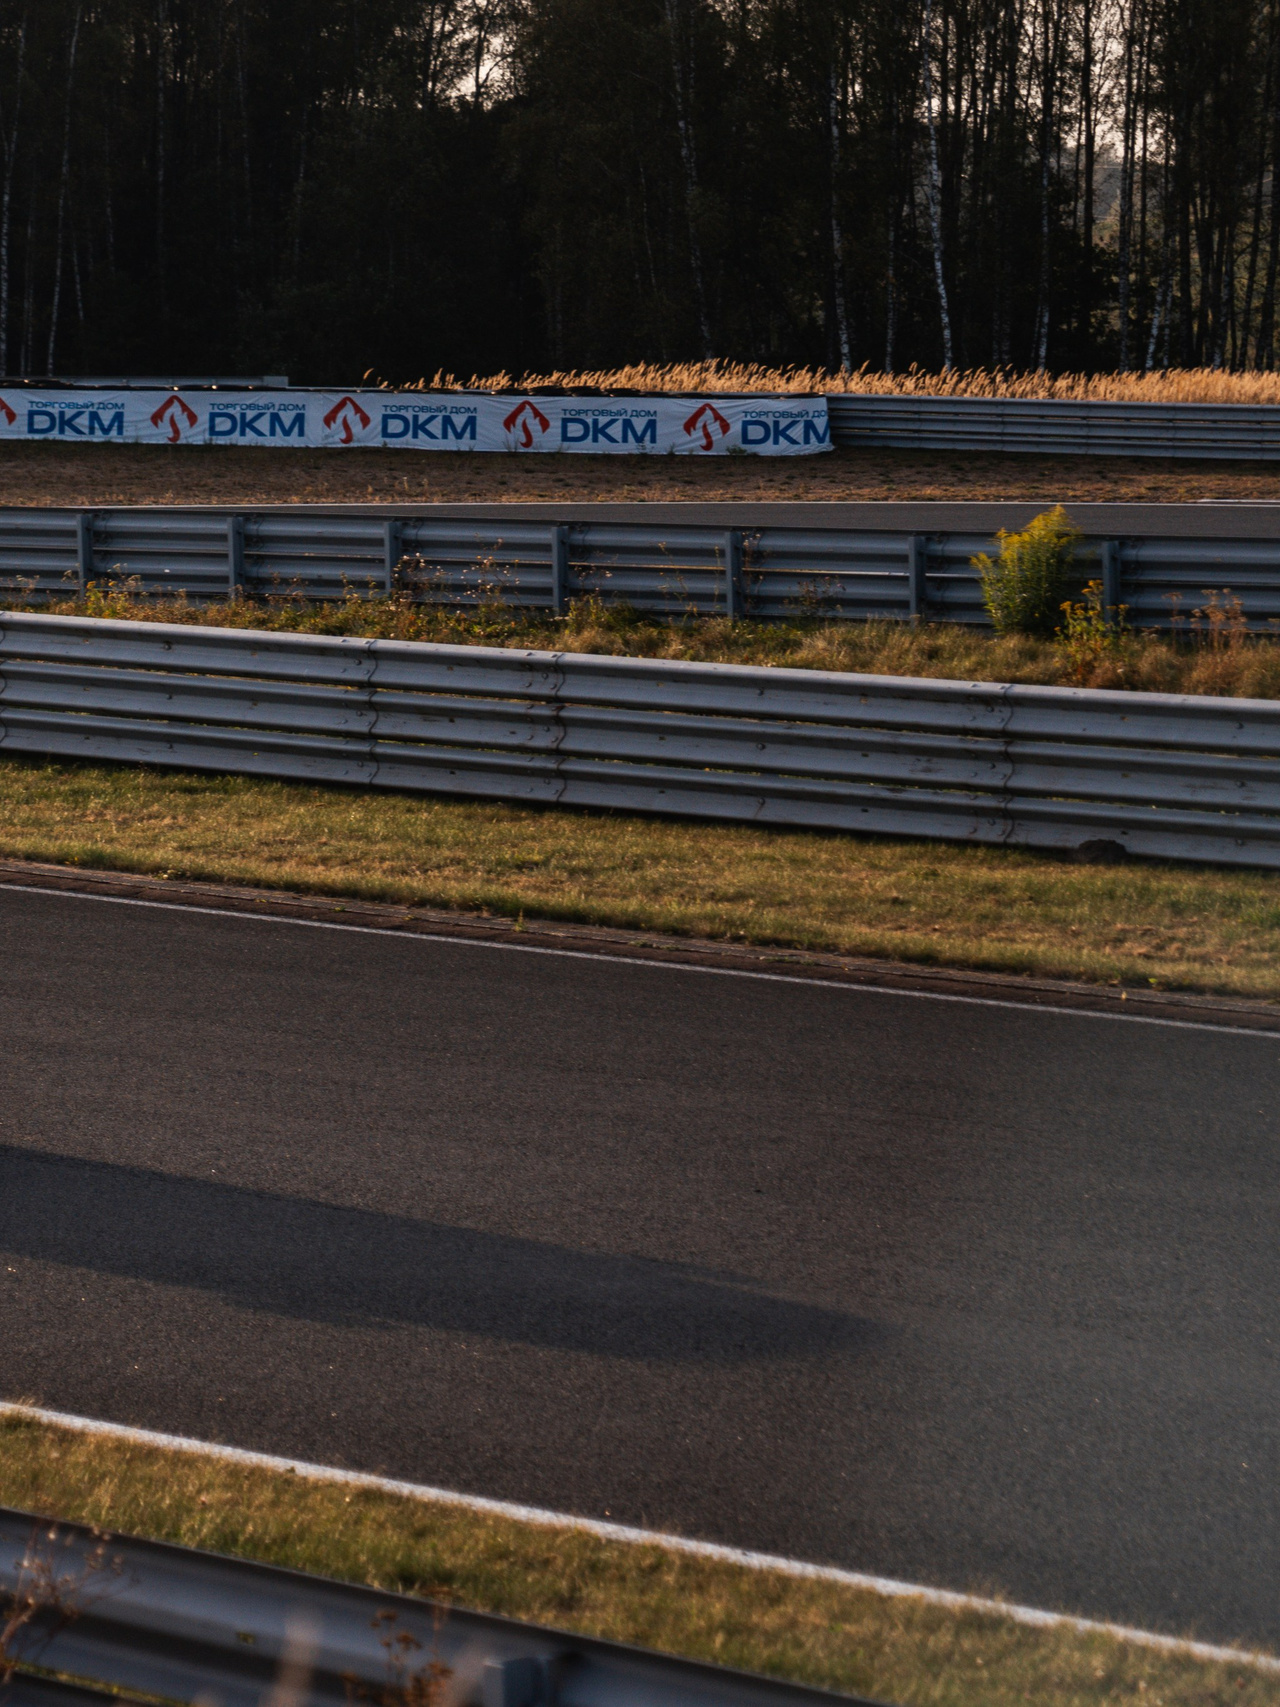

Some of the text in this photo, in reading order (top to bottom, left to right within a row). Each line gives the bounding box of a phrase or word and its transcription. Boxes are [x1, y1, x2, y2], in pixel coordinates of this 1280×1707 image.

[27, 401, 125, 410] ТОРГОВЫЙ ДОМ
[208, 402, 306, 411] ТОРГОВЫЙ ДОМ
[381, 404, 477, 414] ТОРГОВЫЙ ДОМ
[561, 408, 657, 418] ТОРГОВЫЙ ДОМ
[741, 409, 827, 419] ТОРГОВЫЙ ДО
[27, 410, 125, 436] DKM
[208, 411, 306, 438] DKM
[381, 413, 477, 440] DKM
[561, 418, 657, 444] DKM
